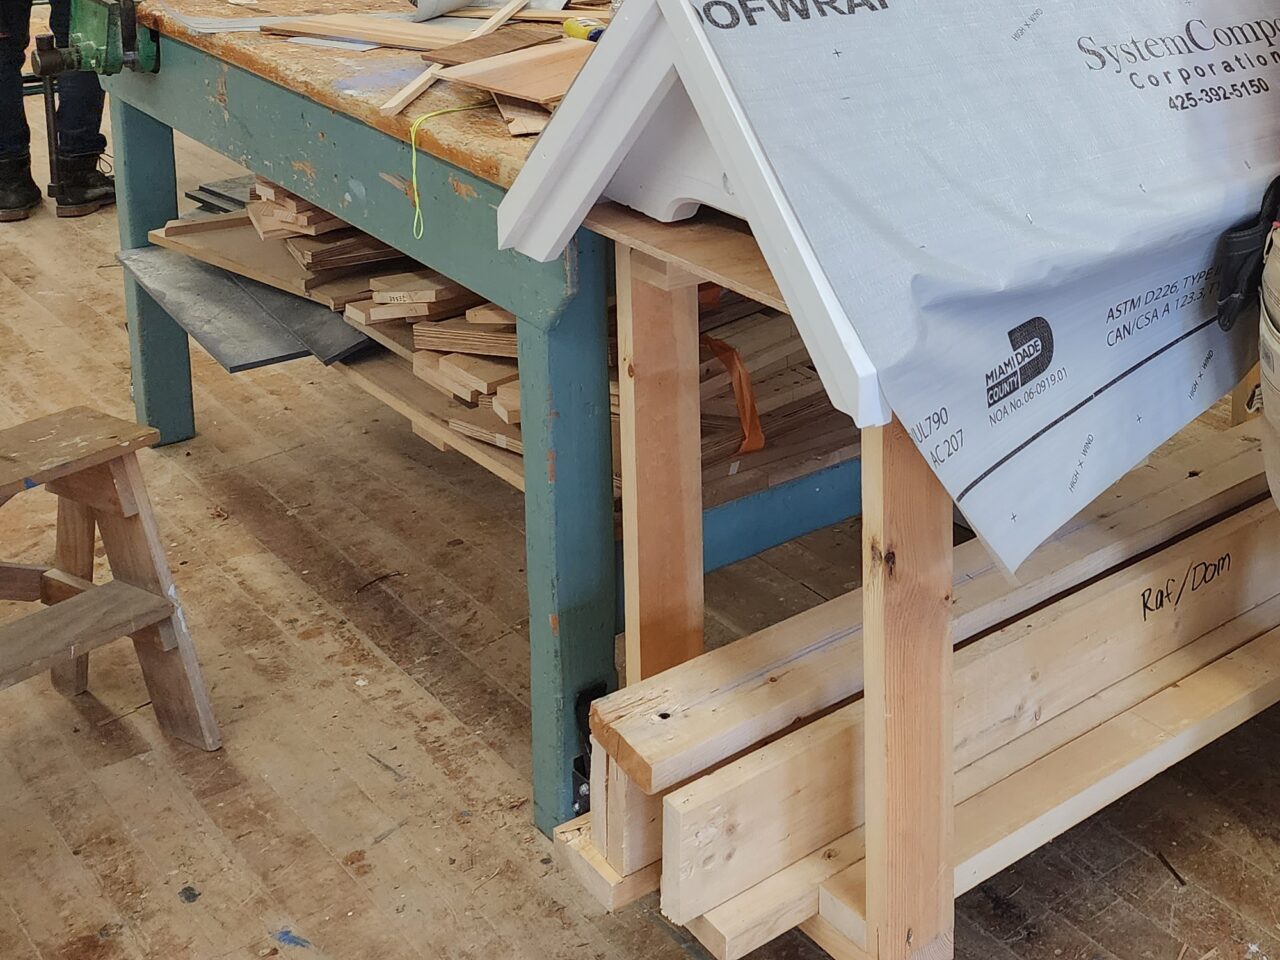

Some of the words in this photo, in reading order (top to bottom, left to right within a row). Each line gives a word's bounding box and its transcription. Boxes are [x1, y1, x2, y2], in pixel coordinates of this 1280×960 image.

[1168, 77, 1270, 112] 425-392-5150
[1106, 295, 1142, 324] ASTM
[1144, 281, 1180, 306] D226,
[1183, 267, 1213, 289] TYPE
[1106, 308, 1159, 347] CAN/CSA
[1162, 302, 1170, 318] A
[985, 356, 1017, 386] MIAMI
[1015, 339, 1041, 366] DADE
[1188, 380, 1198, 400] HIGH
[1202, 349, 1214, 370] WIND
[988, 374, 1019, 404] COUNTY
[989, 405, 1010, 427] NOA
[1010, 397, 1024, 414] No.
[1023, 366, 1069, 403] 06-0919.01
[911, 407, 949, 444] UL790
[929, 445, 946, 469] AC
[943, 429, 964, 458] 207
[1069, 469, 1080, 493] HIGH
[1081, 434, 1094, 457] WIND
[1141, 552, 1232, 622] Raf/Dom
